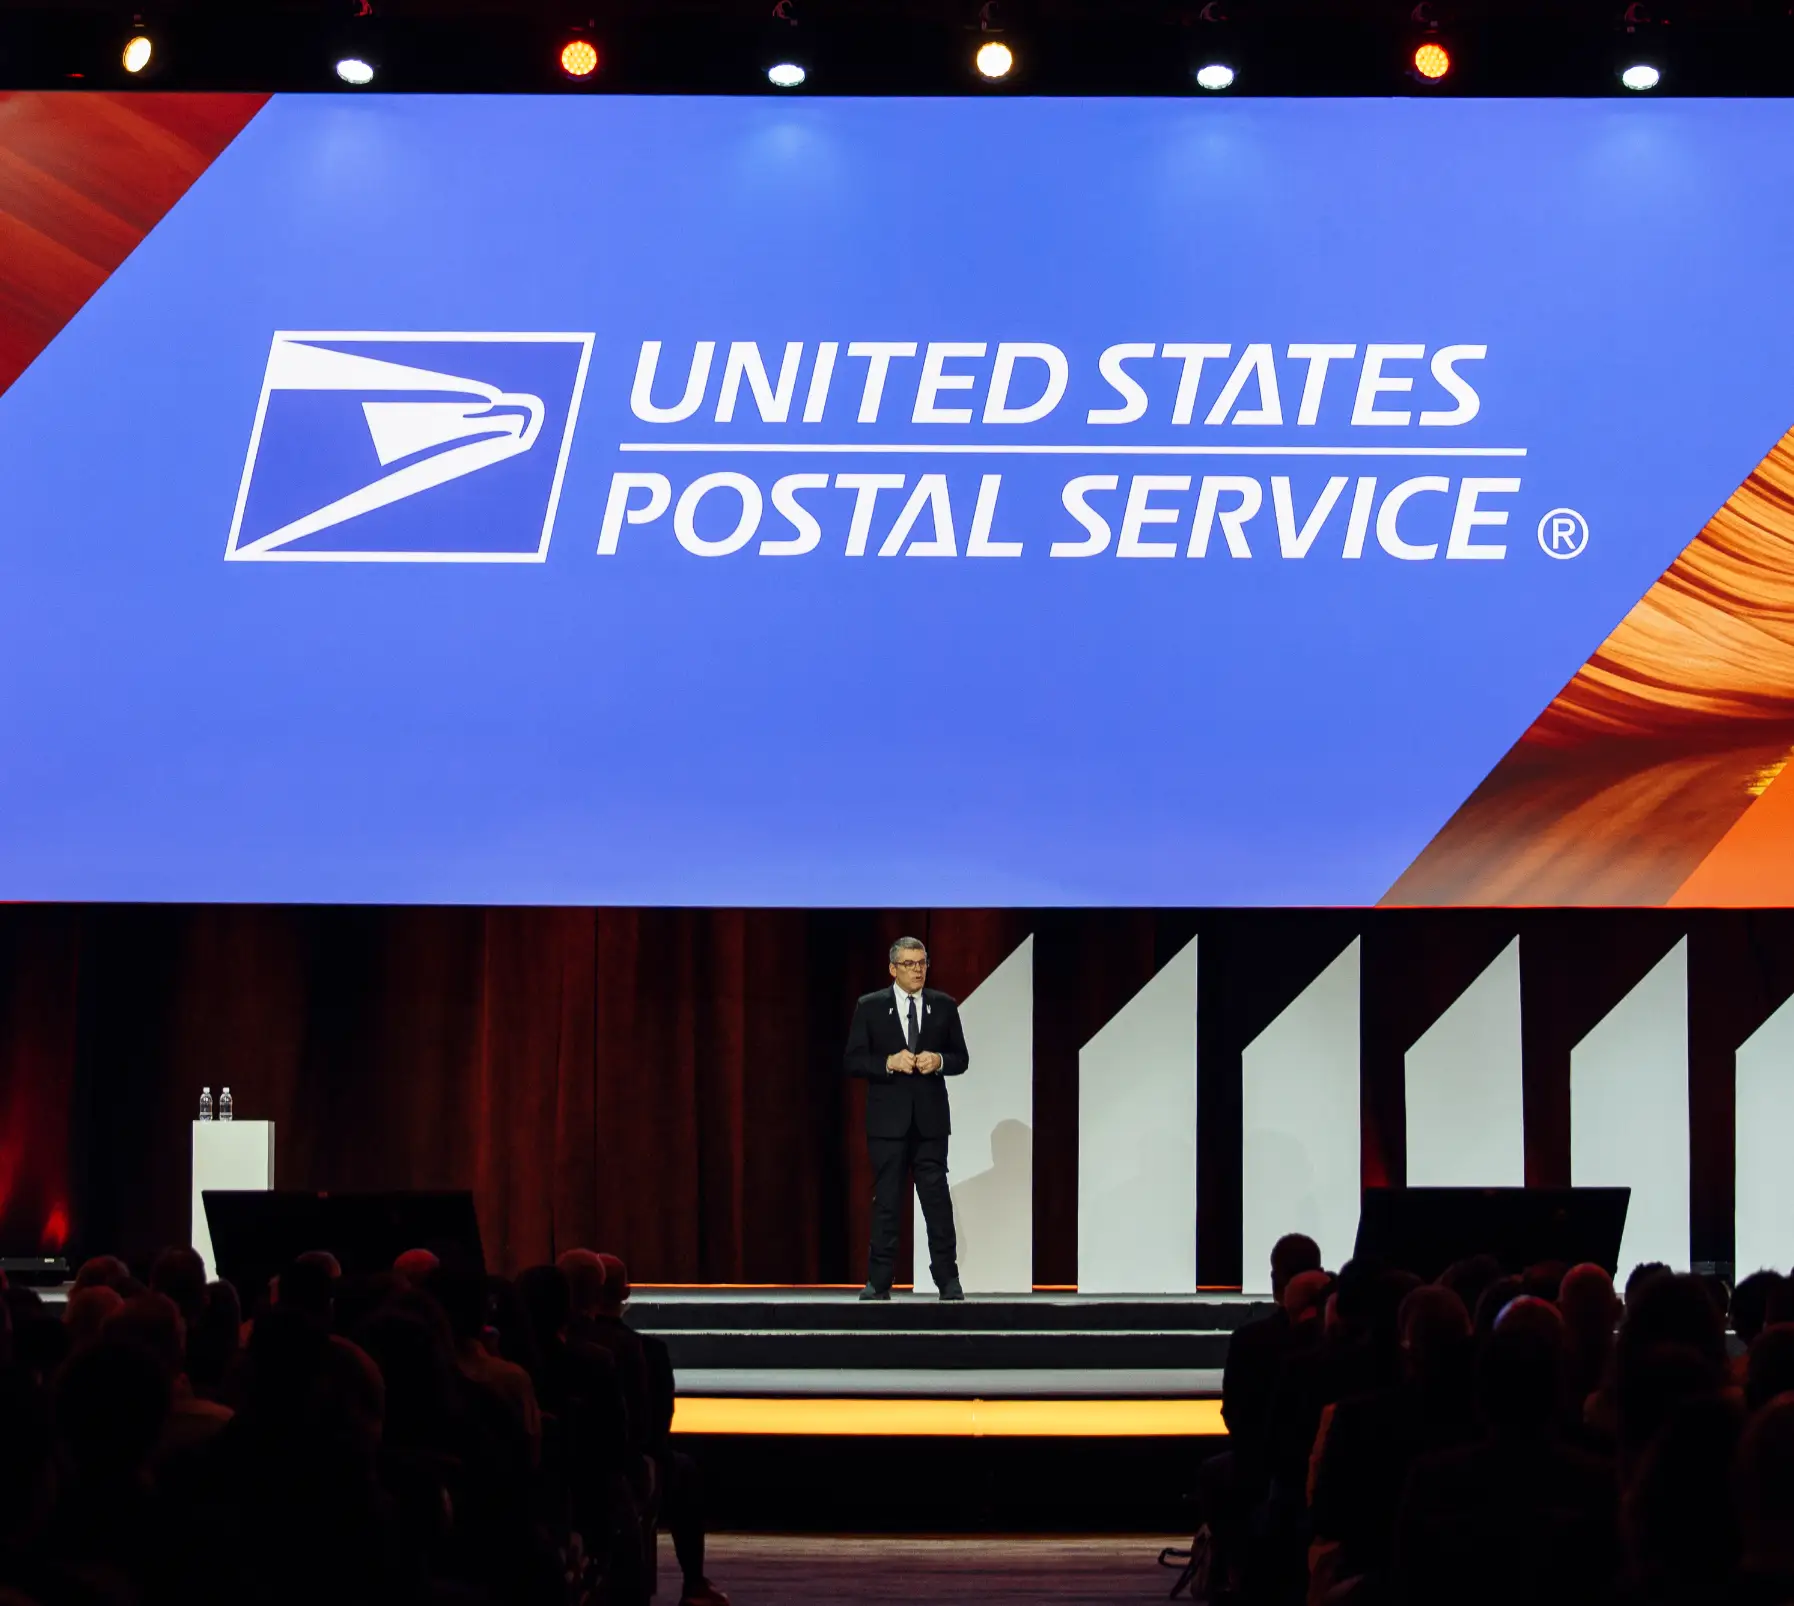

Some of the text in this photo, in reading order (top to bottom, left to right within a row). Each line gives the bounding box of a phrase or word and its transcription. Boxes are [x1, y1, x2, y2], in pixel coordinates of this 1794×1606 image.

[630, 341, 1488, 426] UNITED STATES
[597, 473, 1024, 557] POSTAL
[1049, 475, 1522, 560] SERVICE
